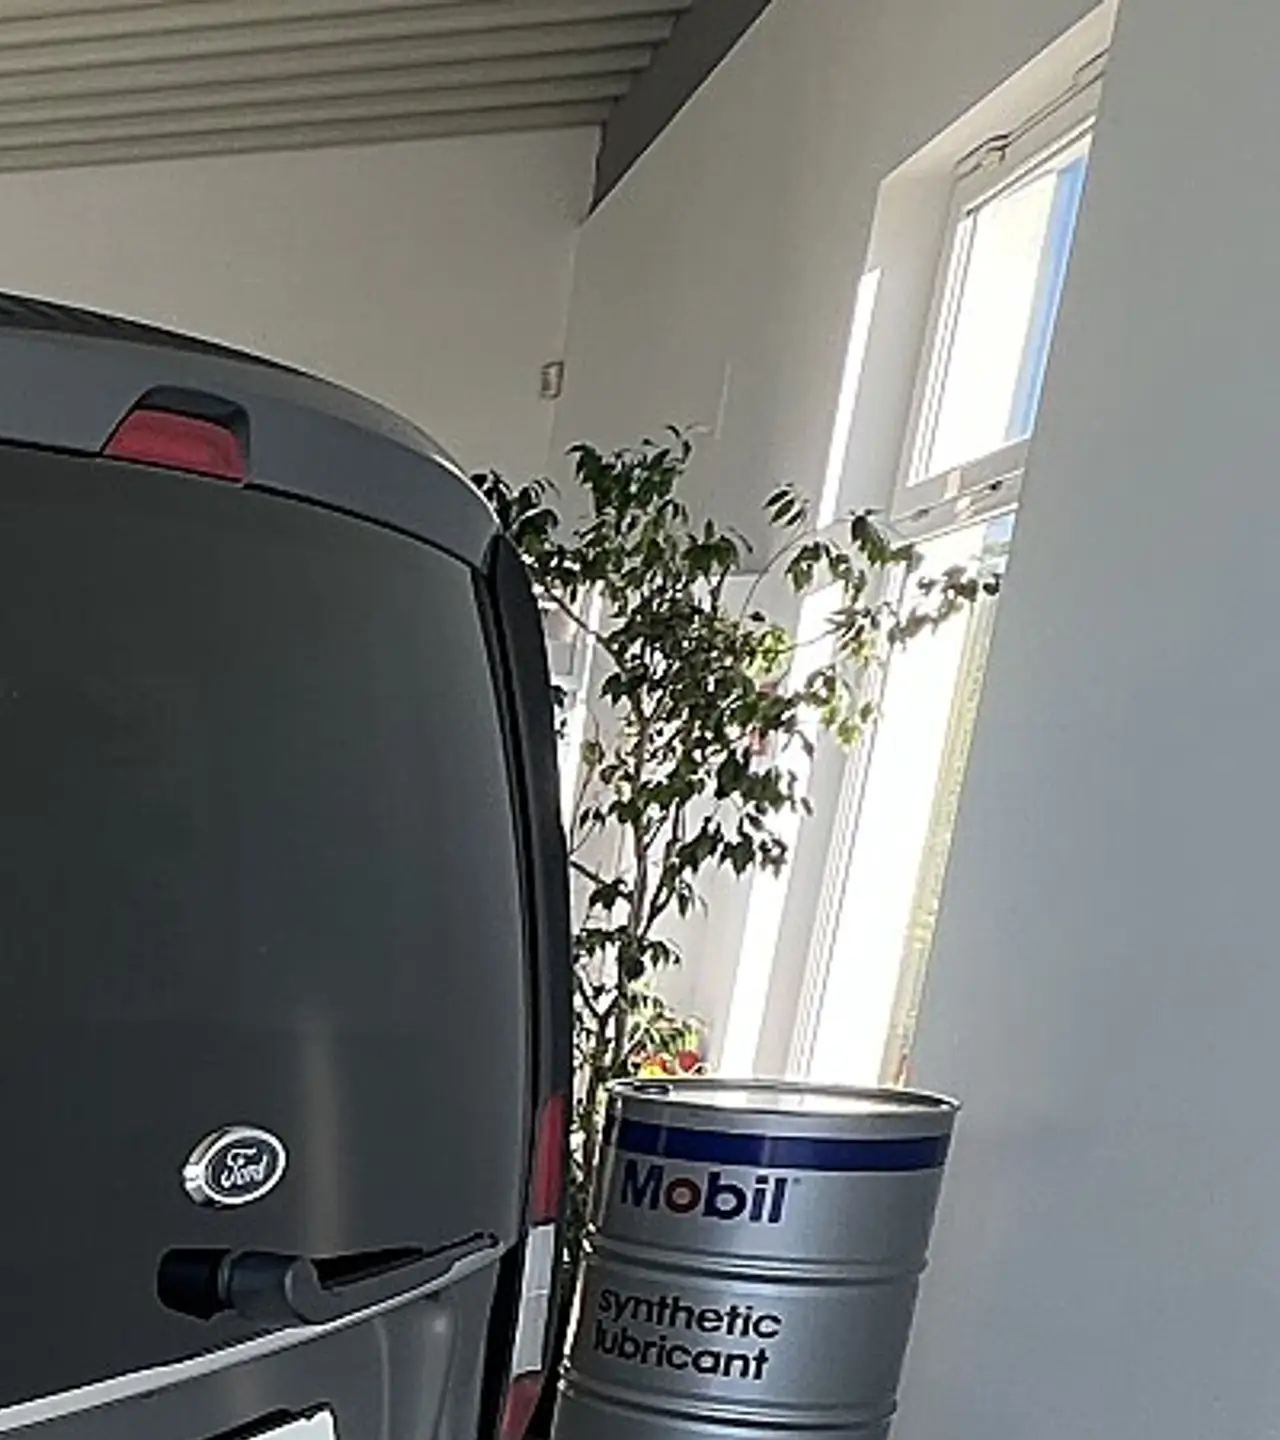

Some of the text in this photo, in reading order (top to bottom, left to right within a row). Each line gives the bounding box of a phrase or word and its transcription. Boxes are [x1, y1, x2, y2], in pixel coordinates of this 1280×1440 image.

[221, 1146, 268, 1188] Ford
[620, 1158, 788, 1224] Mobil
[598, 1288, 783, 1340] synthetic
[594, 1318, 769, 1381] lubricant
